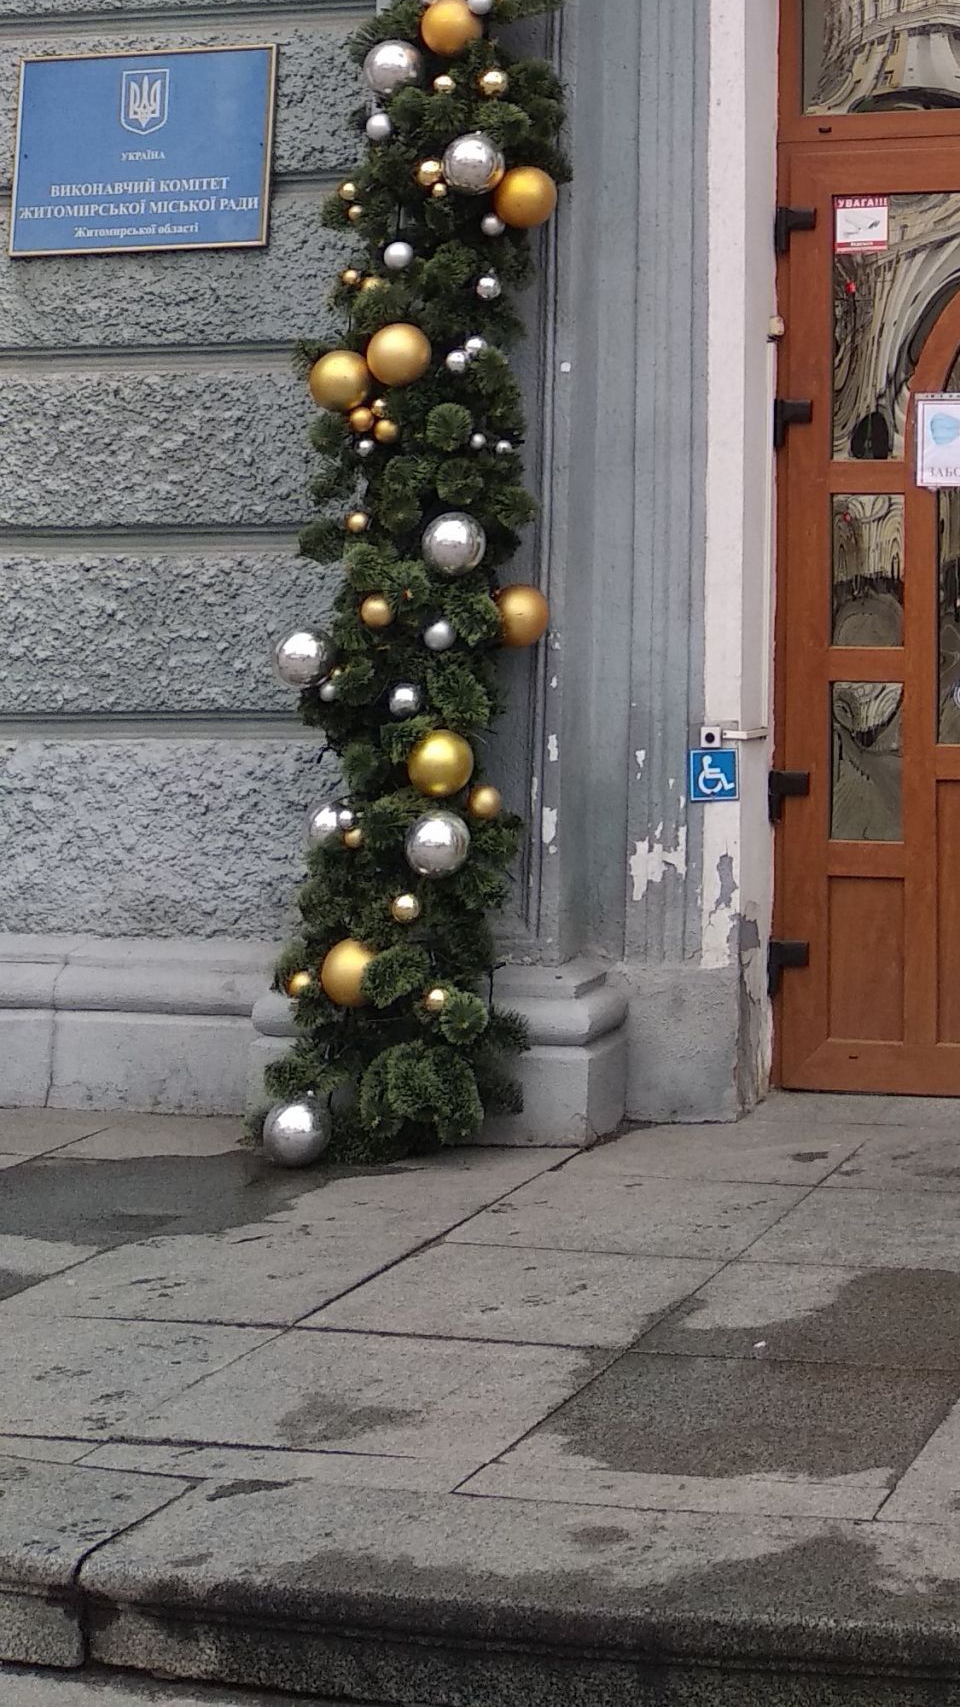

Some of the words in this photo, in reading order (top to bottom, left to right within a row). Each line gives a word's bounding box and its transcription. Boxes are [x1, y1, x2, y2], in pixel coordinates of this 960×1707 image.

[121, 149, 165, 161] УКРАЇНА
[50, 178, 156, 198] ВИКОНАВЧИЙ
[159, 176, 230, 193] КОМІТЕТ
[19, 199, 146, 219] ЖИТОМИРСЬКОЇ
[149, 196, 216, 214] МІСЬКОЇ
[219, 196, 259, 211] РАДИ
[73, 224, 157, 239] Житомирської
[157, 222, 199, 235] області
